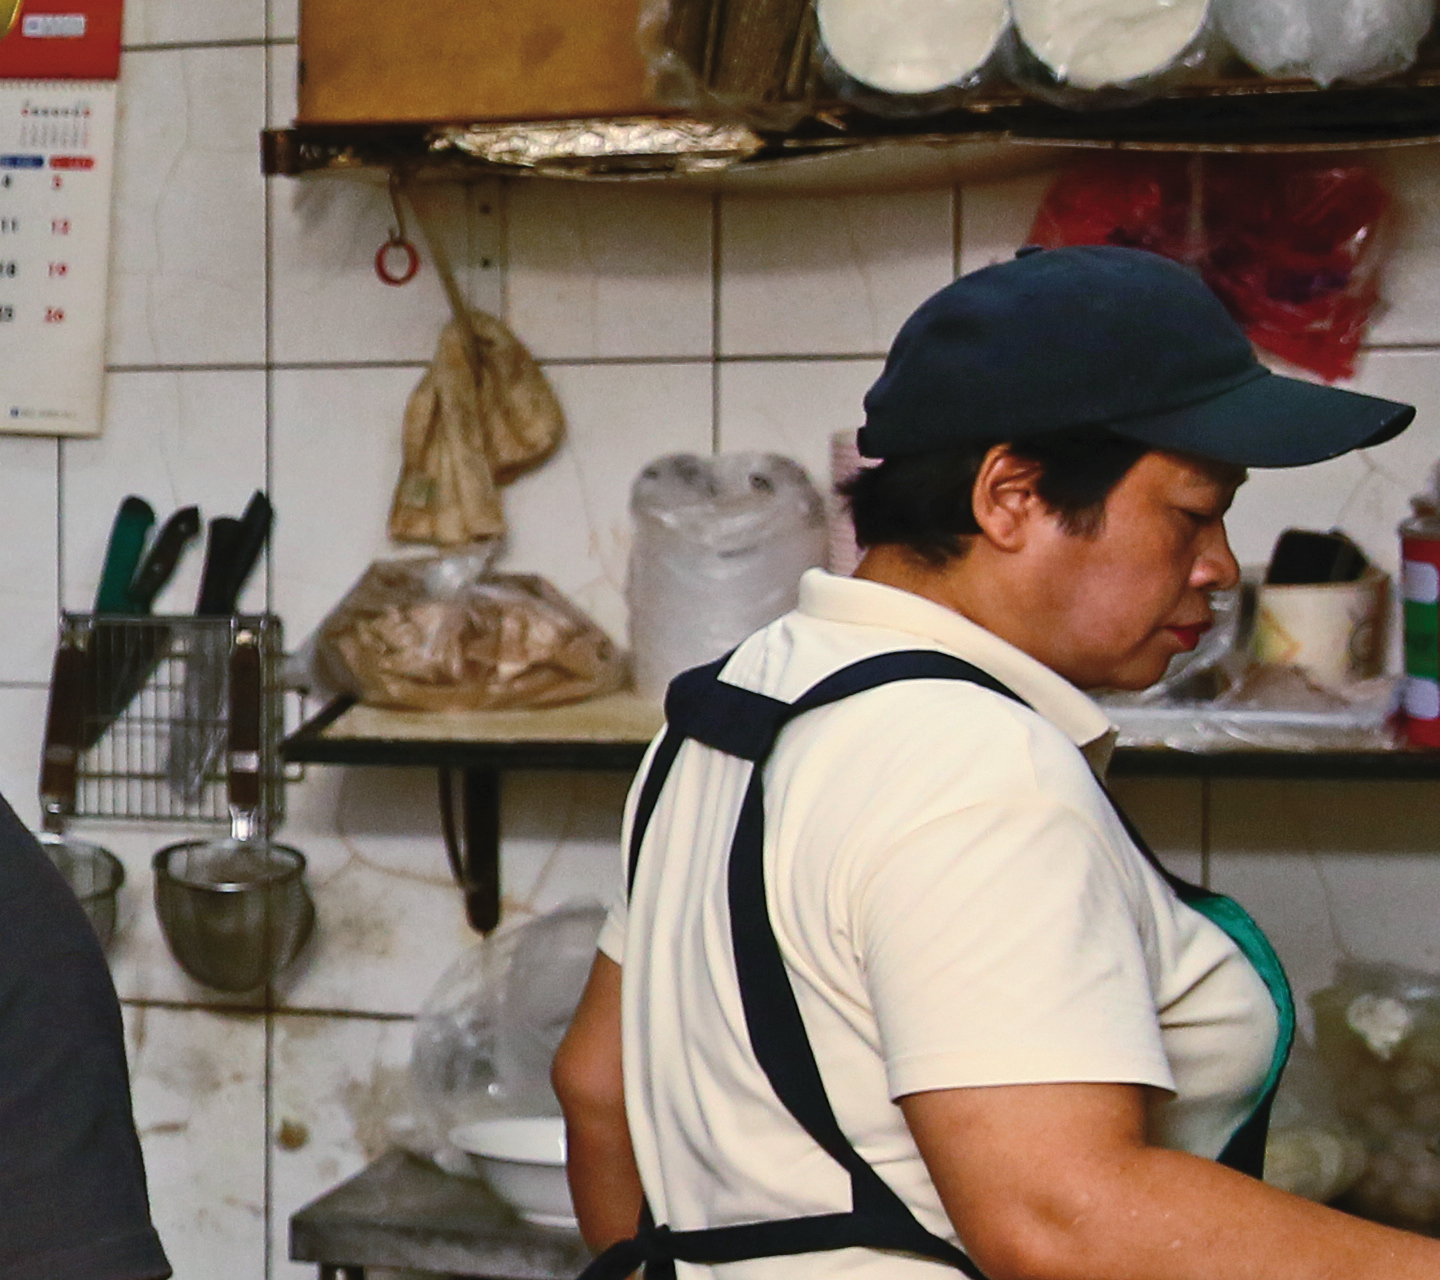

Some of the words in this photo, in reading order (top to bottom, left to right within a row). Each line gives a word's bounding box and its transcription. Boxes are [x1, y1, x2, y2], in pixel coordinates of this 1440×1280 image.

[0, 218, 19, 233] 11
[0, 262, 17, 277] 18
[45, 308, 65, 323] 26
